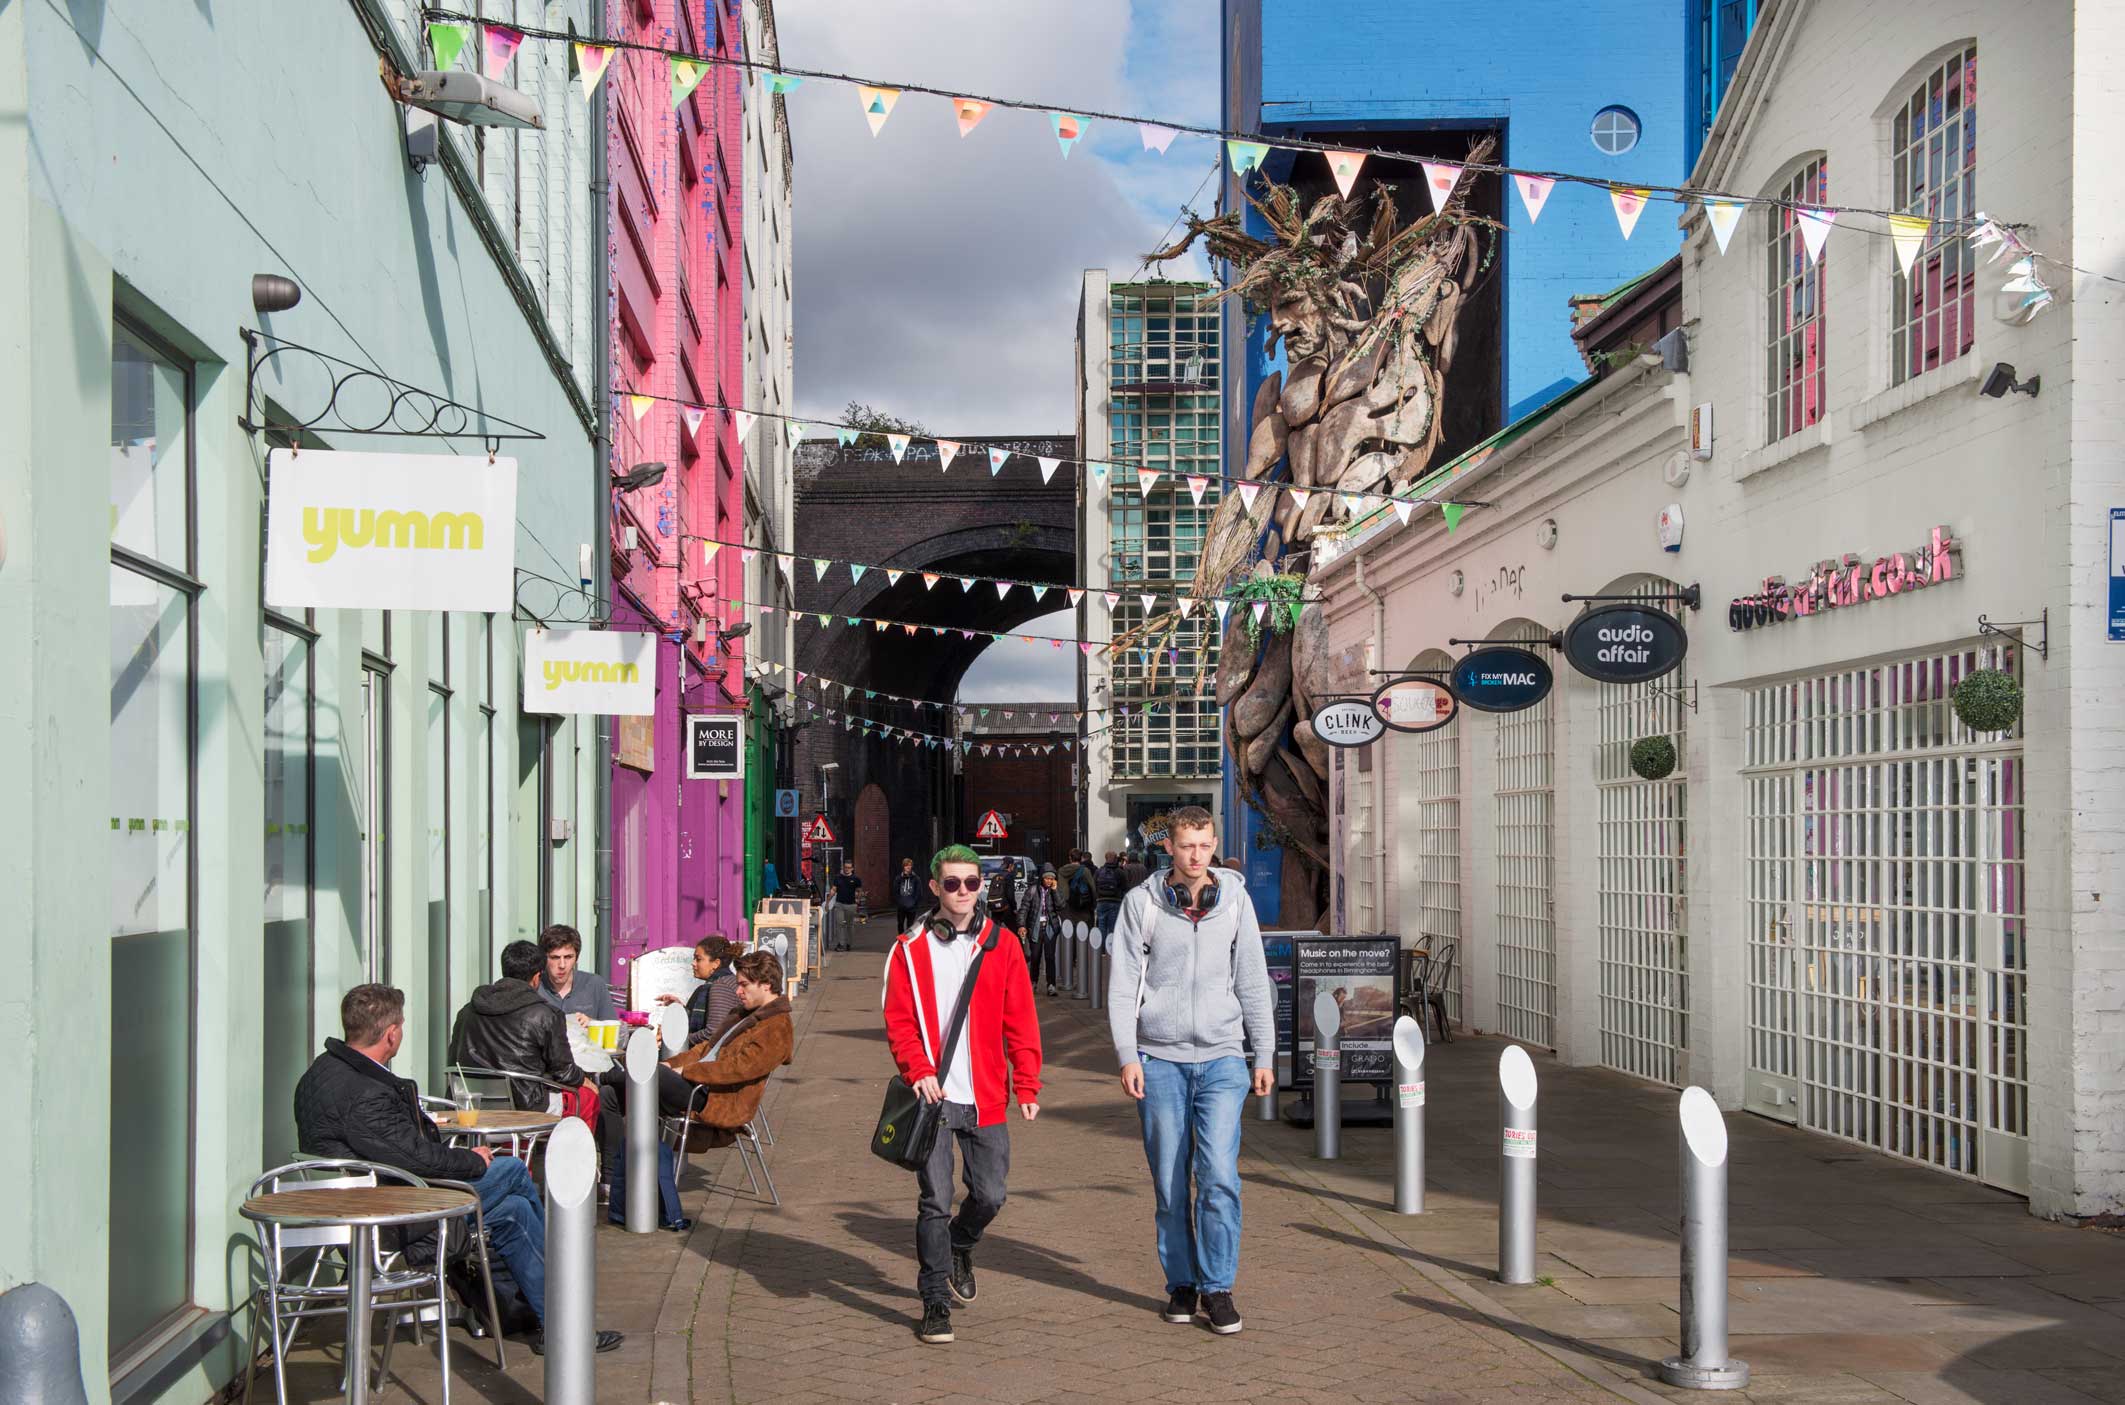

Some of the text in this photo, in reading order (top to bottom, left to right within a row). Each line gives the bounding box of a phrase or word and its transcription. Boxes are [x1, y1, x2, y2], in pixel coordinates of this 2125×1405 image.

[303, 506, 484, 564] yumm
[1598, 624, 1654, 642] audio
[1597, 645, 1650, 663] affair
[543, 660, 639, 691] yumm
[1503, 673, 1536, 686] MAC
[1325, 713, 1373, 730] CLINK
[699, 729, 734, 740] MORE
[1301, 949, 1327, 958] Music
[1329, 950, 1341, 958] on
[1342, 949, 1357, 958] the
[1359, 949, 1390, 958] move?
